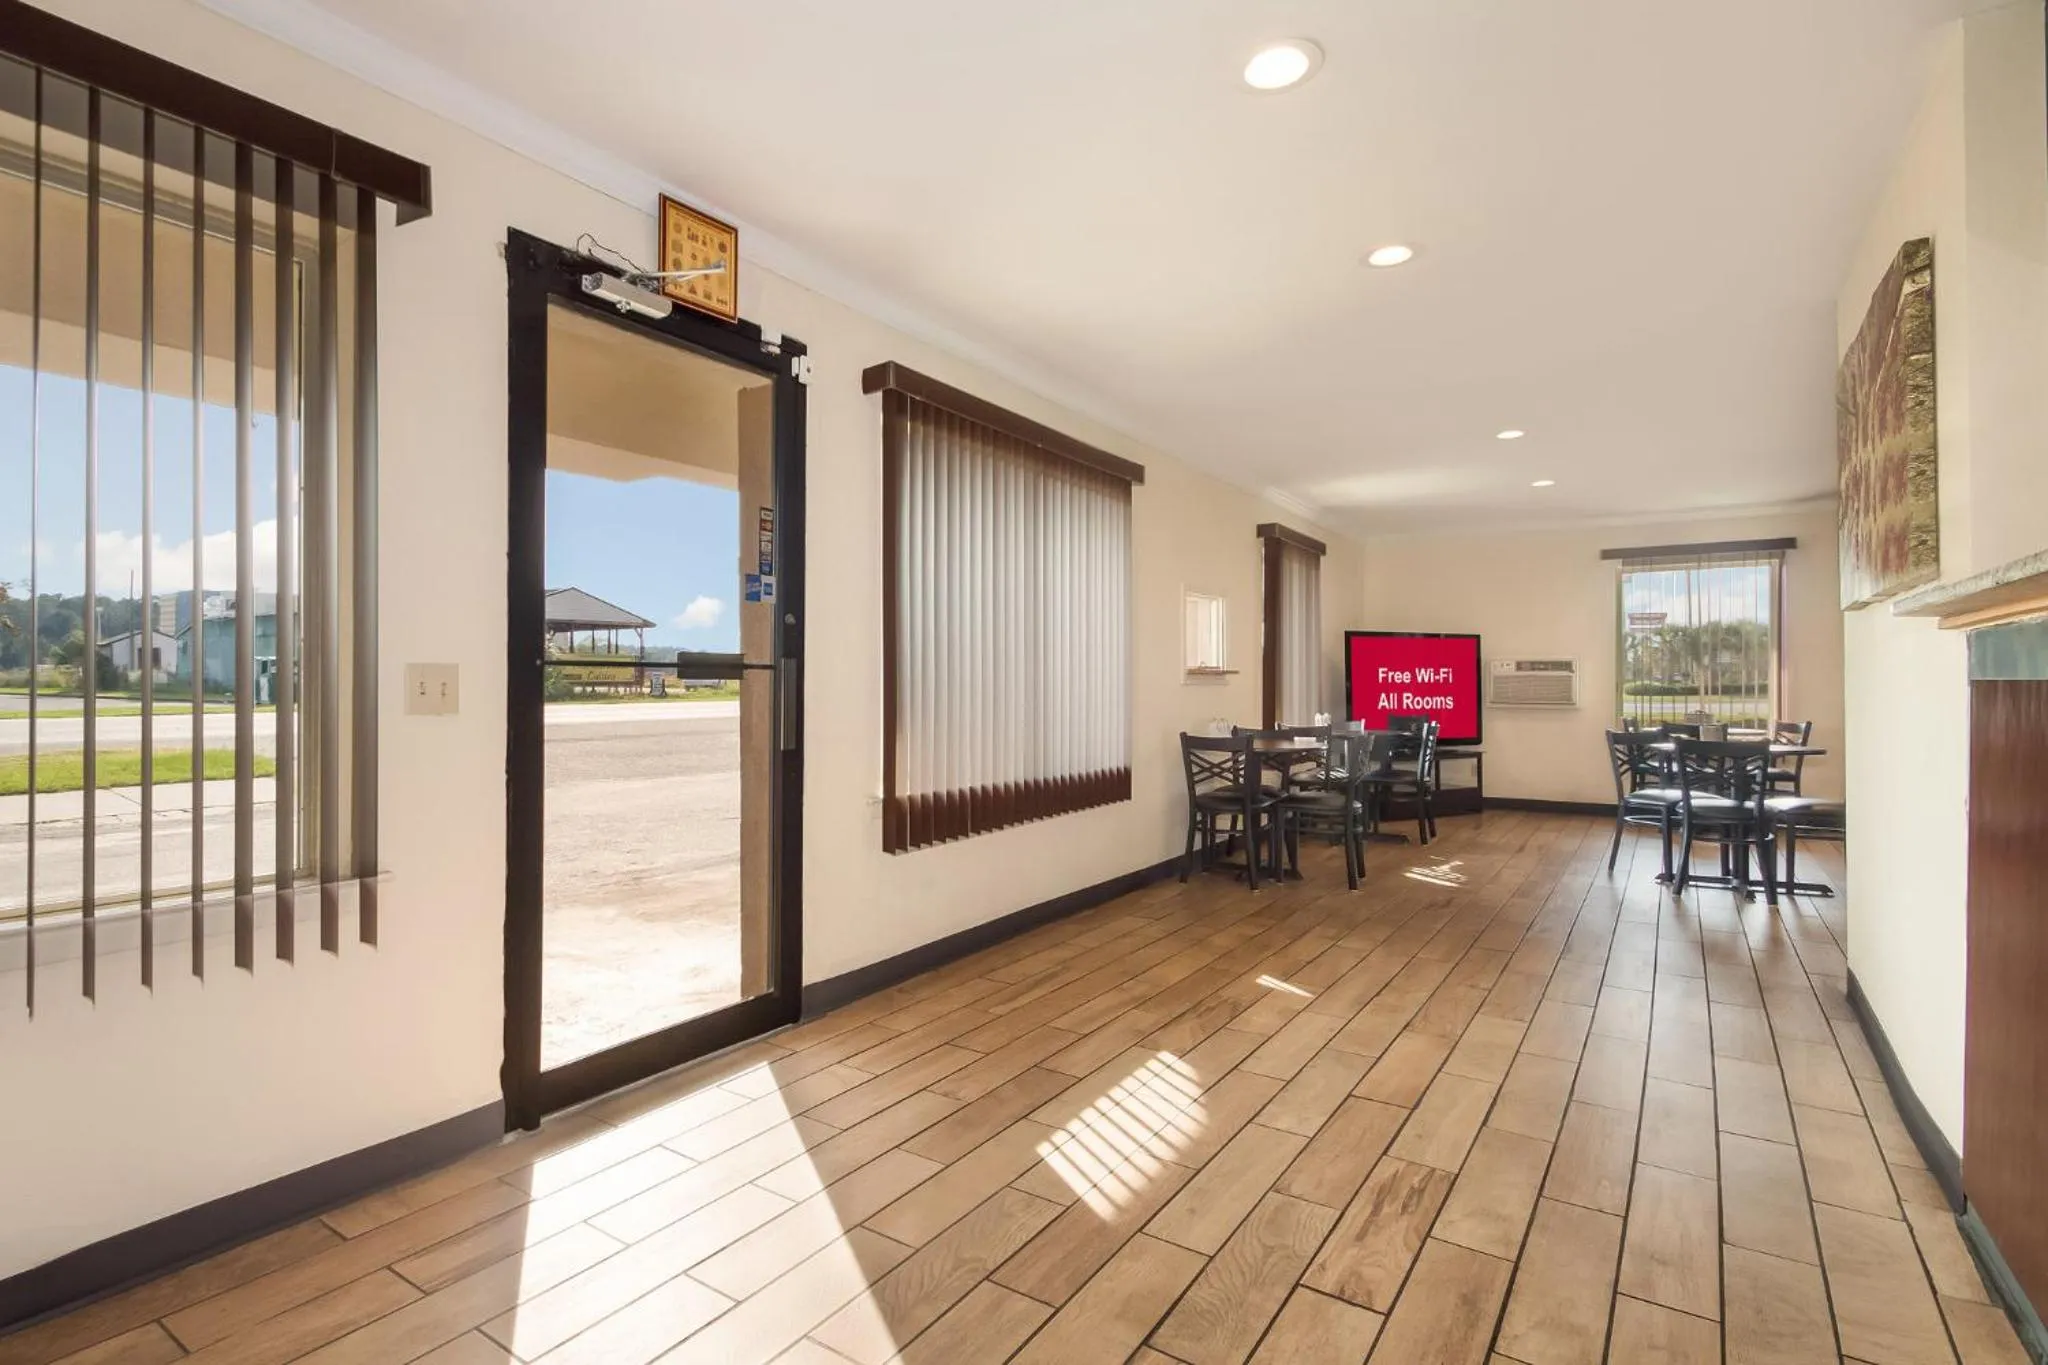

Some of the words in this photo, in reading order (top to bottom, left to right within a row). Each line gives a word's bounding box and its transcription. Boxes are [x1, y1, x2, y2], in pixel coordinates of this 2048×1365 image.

[1378, 667, 1411, 684] Free
[1415, 667, 1453, 684] Wi-Fi
[1377, 692, 1398, 710] All
[1402, 692, 1454, 710] Rooms
